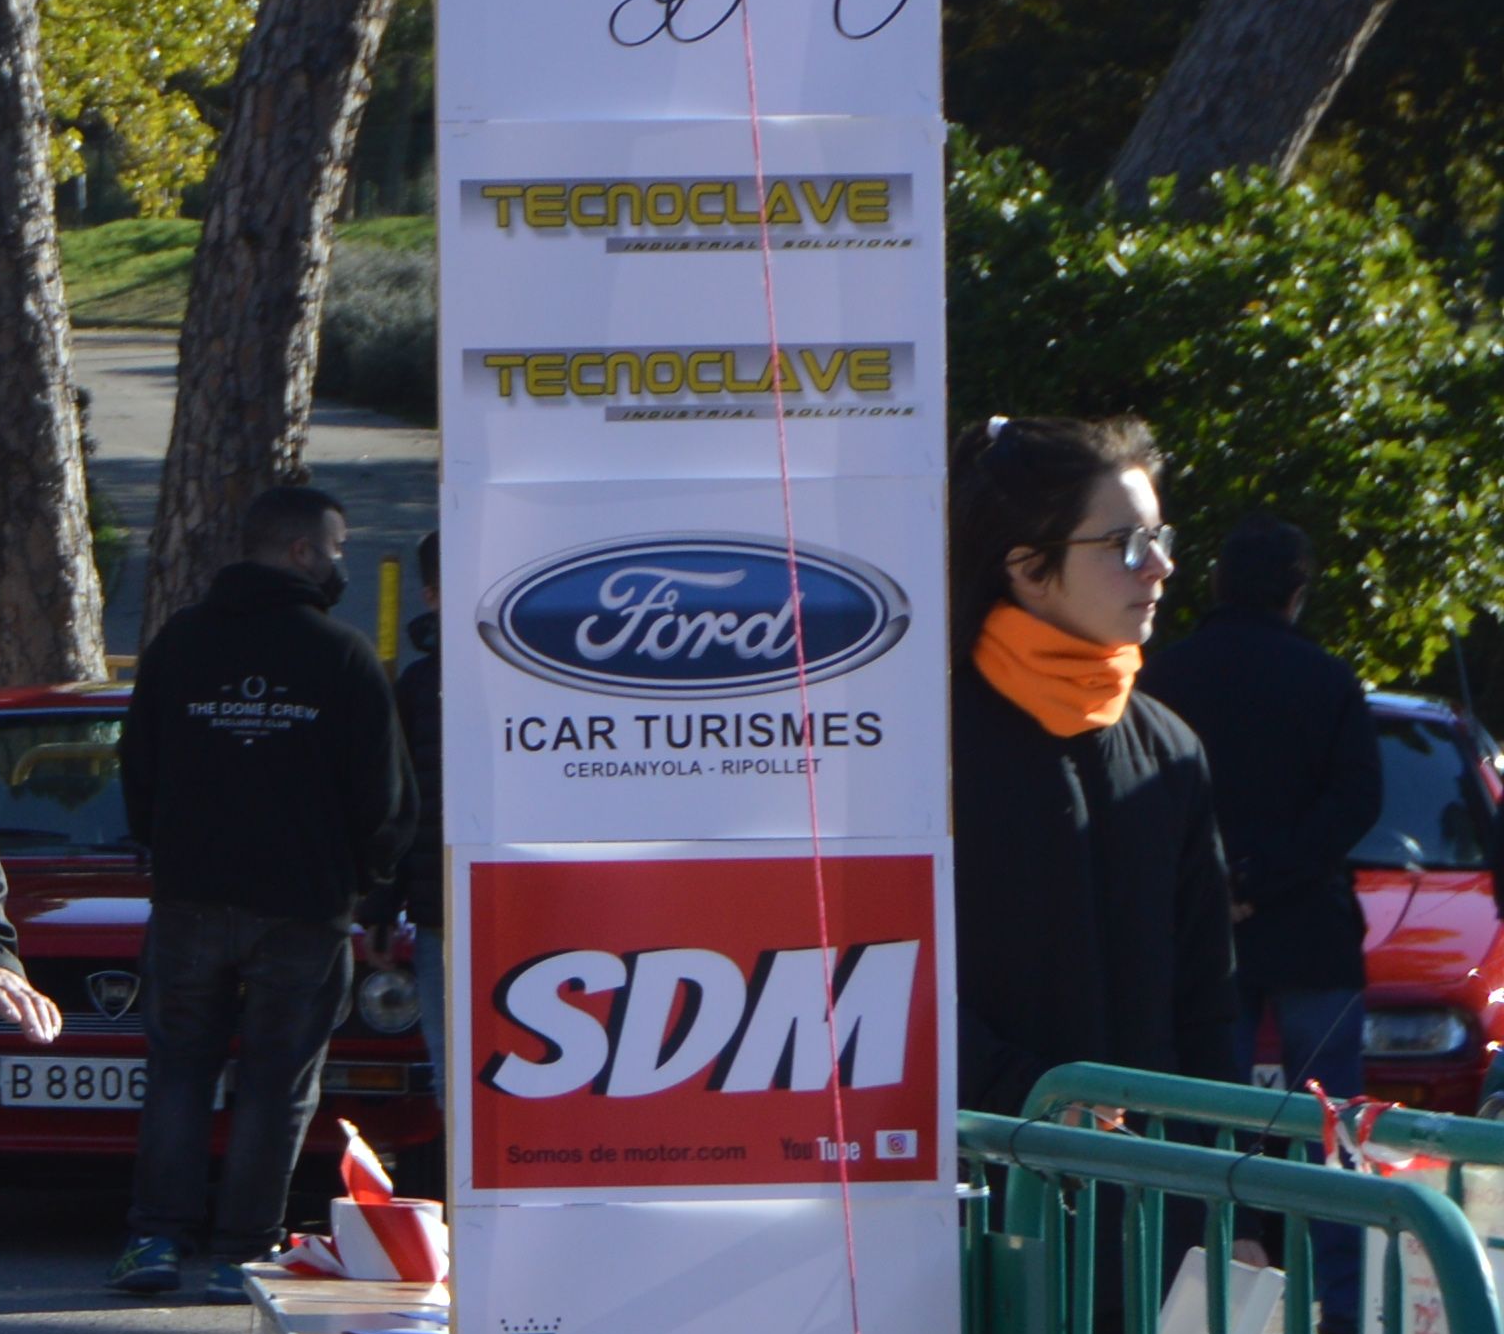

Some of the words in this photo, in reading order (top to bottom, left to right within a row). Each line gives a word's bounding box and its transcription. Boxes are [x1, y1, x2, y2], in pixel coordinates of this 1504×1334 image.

[481, 179, 891, 228] TECNOCLAVE
[623, 241, 758, 251] INDUSTRIAL
[783, 238, 913, 249] SOLUTIONS
[483, 348, 893, 397] TECNOCLAVE
[621, 409, 758, 420] INDUSTRIAL
[783, 406, 915, 417] SOLUTIONS
[574, 565, 808, 662] Ford
[188, 702, 217, 716] THE
[221, 702, 267, 716] DOME
[270, 703, 320, 721] CREW
[504, 715, 617, 753] iCAR
[635, 711, 885, 751] TURISMES
[562, 759, 702, 779] CERDANYOLA
[720, 758, 823, 776] RIPOLLET
[479, 938, 922, 1099] SDM
[11, 1064, 33, 1100] B
[506, 1145, 582, 1164] Somos
[589, 1145, 617, 1164] de
[624, 1143, 747, 1164] motor.com
